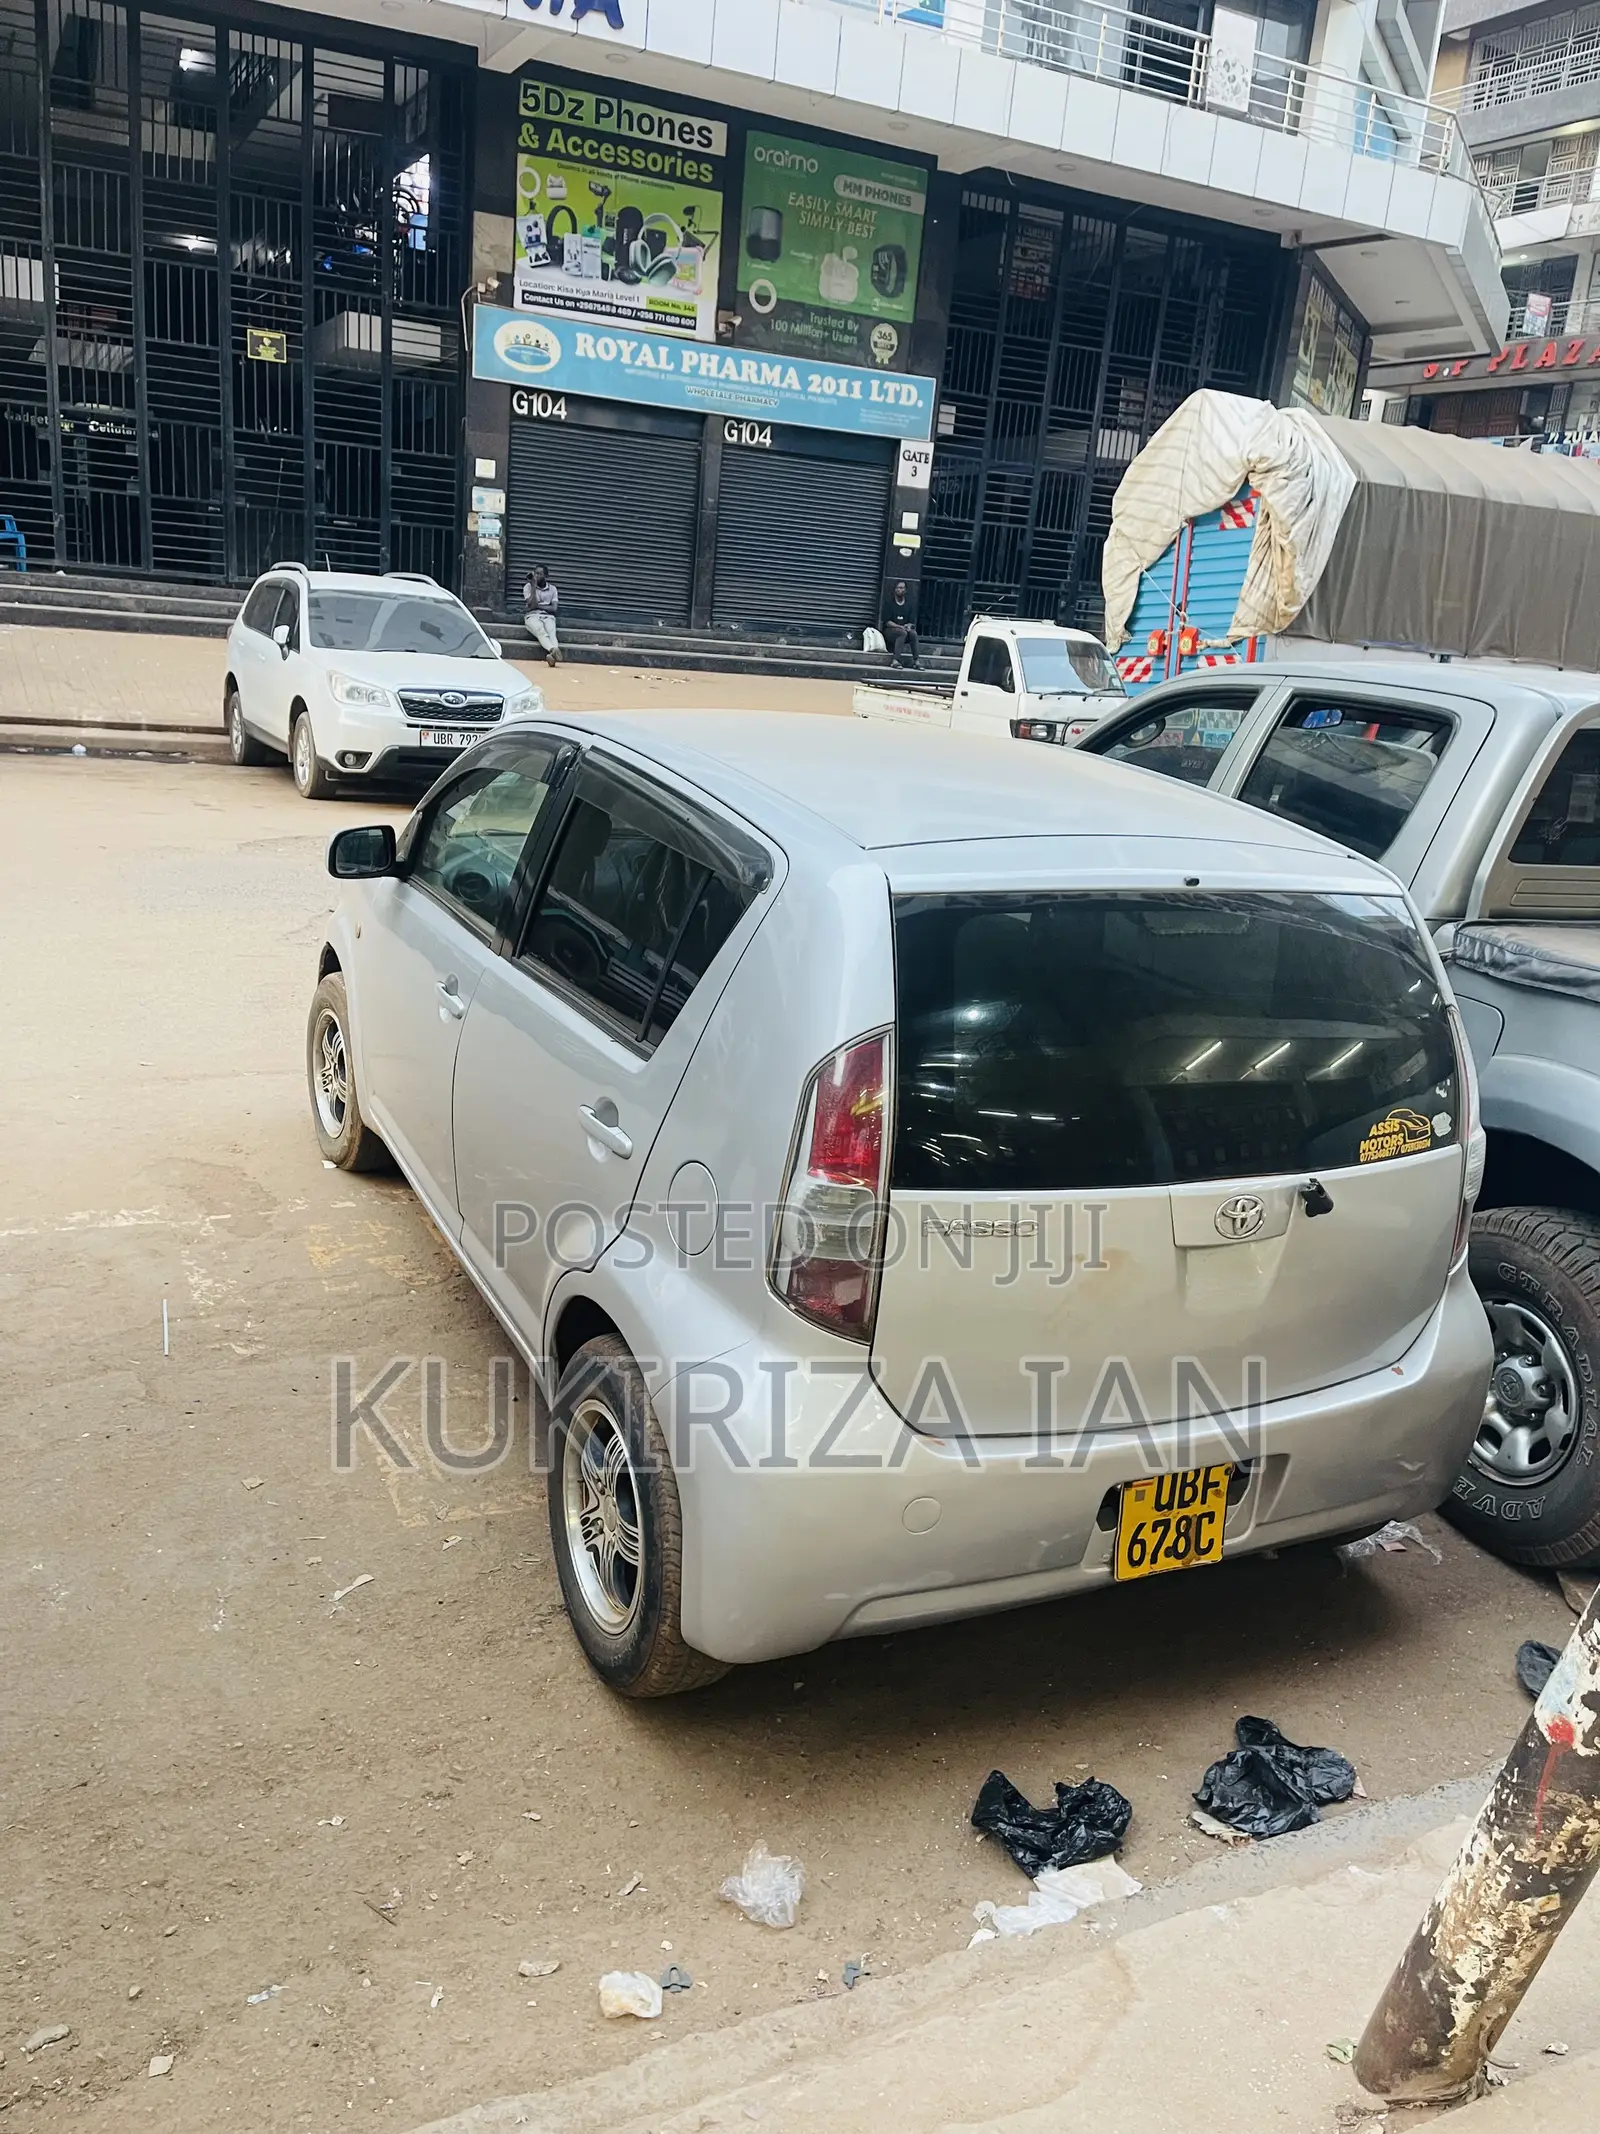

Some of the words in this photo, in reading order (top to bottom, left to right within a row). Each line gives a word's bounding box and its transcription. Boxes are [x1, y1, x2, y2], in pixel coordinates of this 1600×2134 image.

[522, 82, 584, 121] 5Dz
[594, 98, 713, 149] Phones
[518, 122, 539, 149] &
[546, 128, 713, 183] Accessories
[754, 146, 819, 174] oraimo
[842, 178, 862, 196] MM
[864, 184, 912, 207] PHONES
[788, 191, 831, 213] EASILY
[835, 202, 878, 223] SMART
[799, 211, 843, 233] SIMPLY
[848, 221, 876, 240] BEST
[519, 279, 556, 291] Location:
[557, 284, 574, 294] Kisa
[576, 287, 591, 297] Kya
[593, 289, 614, 300] Maria
[615, 292, 635, 302] Level
[524, 292, 553, 304] Contact
[554, 296, 564, 306] Us
[565, 299, 575, 309] on
[770, 318, 787, 332] 100
[832, 328, 858, 345] Users
[810, 311, 846, 331] Trusted
[848, 318, 860, 332] By
[877, 330, 893, 342] 365
[1486, 339, 1600, 373] PLAZA
[575, 332, 674, 371] ROYAL
[681, 350, 801, 390] PHARMA
[808, 374, 863, 399] 2011
[869, 379, 923, 408] LTD.
[512, 390, 567, 420] G104
[735, 394, 779, 407] PHARMACY
[4, 411, 53, 426] Gadget
[724, 419, 772, 447] G104
[902, 450, 930, 464] GATE
[911, 466, 918, 477] 3
[433, 732, 454, 745] UBR
[1369, 1120, 1401, 1137] ASSIS
[1360, 1133, 1405, 1154] MOTORS
[922, 1218, 1040, 1238] PASSO
[1497, 1262, 1541, 1294] GT
[1542, 1291, 1599, 1467] RADIAL
[1127, 1510, 1216, 1568] 678C
